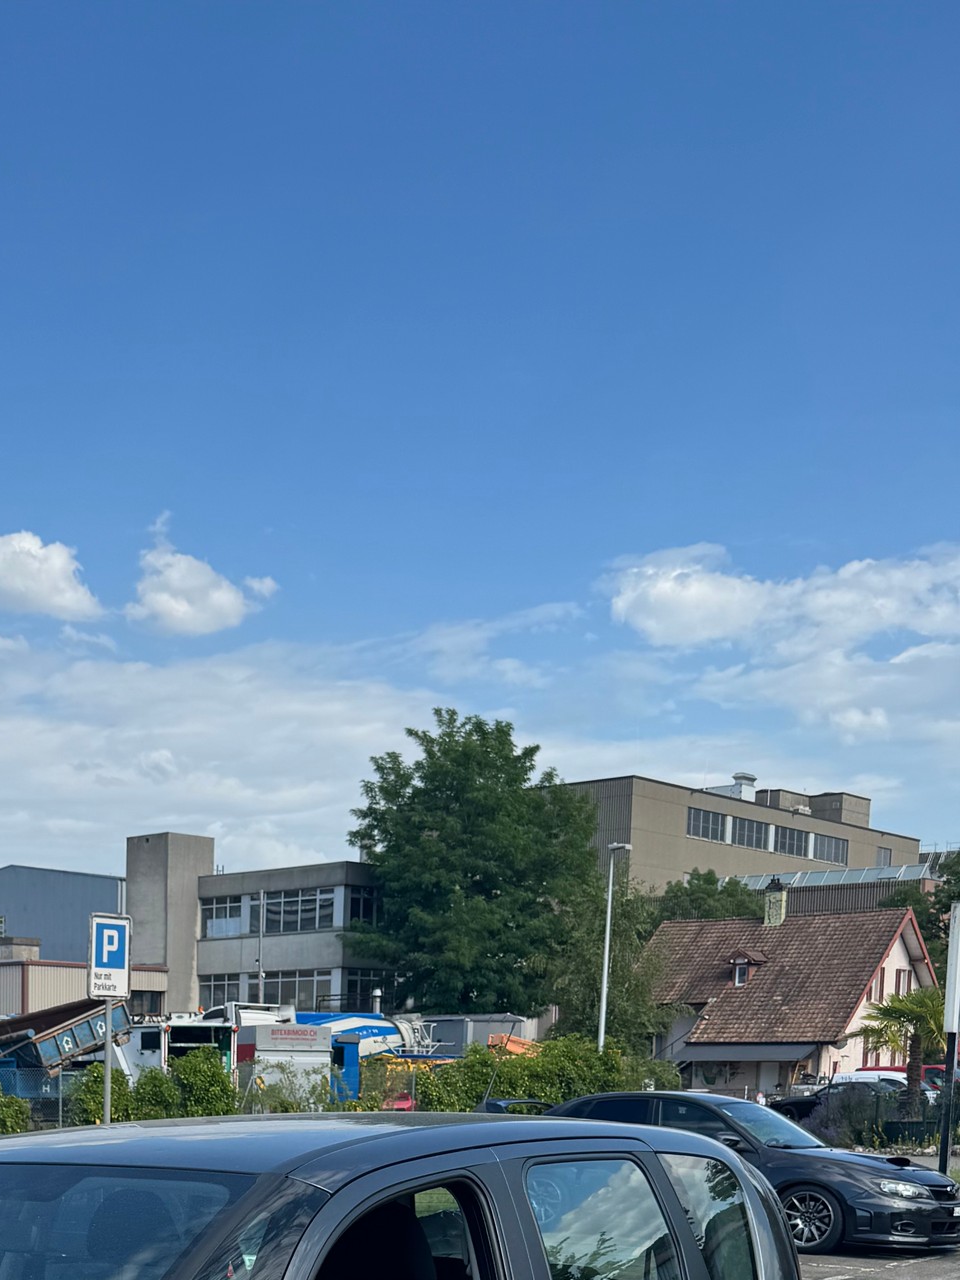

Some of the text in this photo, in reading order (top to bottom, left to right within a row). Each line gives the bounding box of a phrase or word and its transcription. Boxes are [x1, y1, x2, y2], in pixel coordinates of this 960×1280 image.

[102, 928, 119, 963] P
[93, 971, 112, 981] Nur mit
[93, 982, 117, 992] Parkkarte
